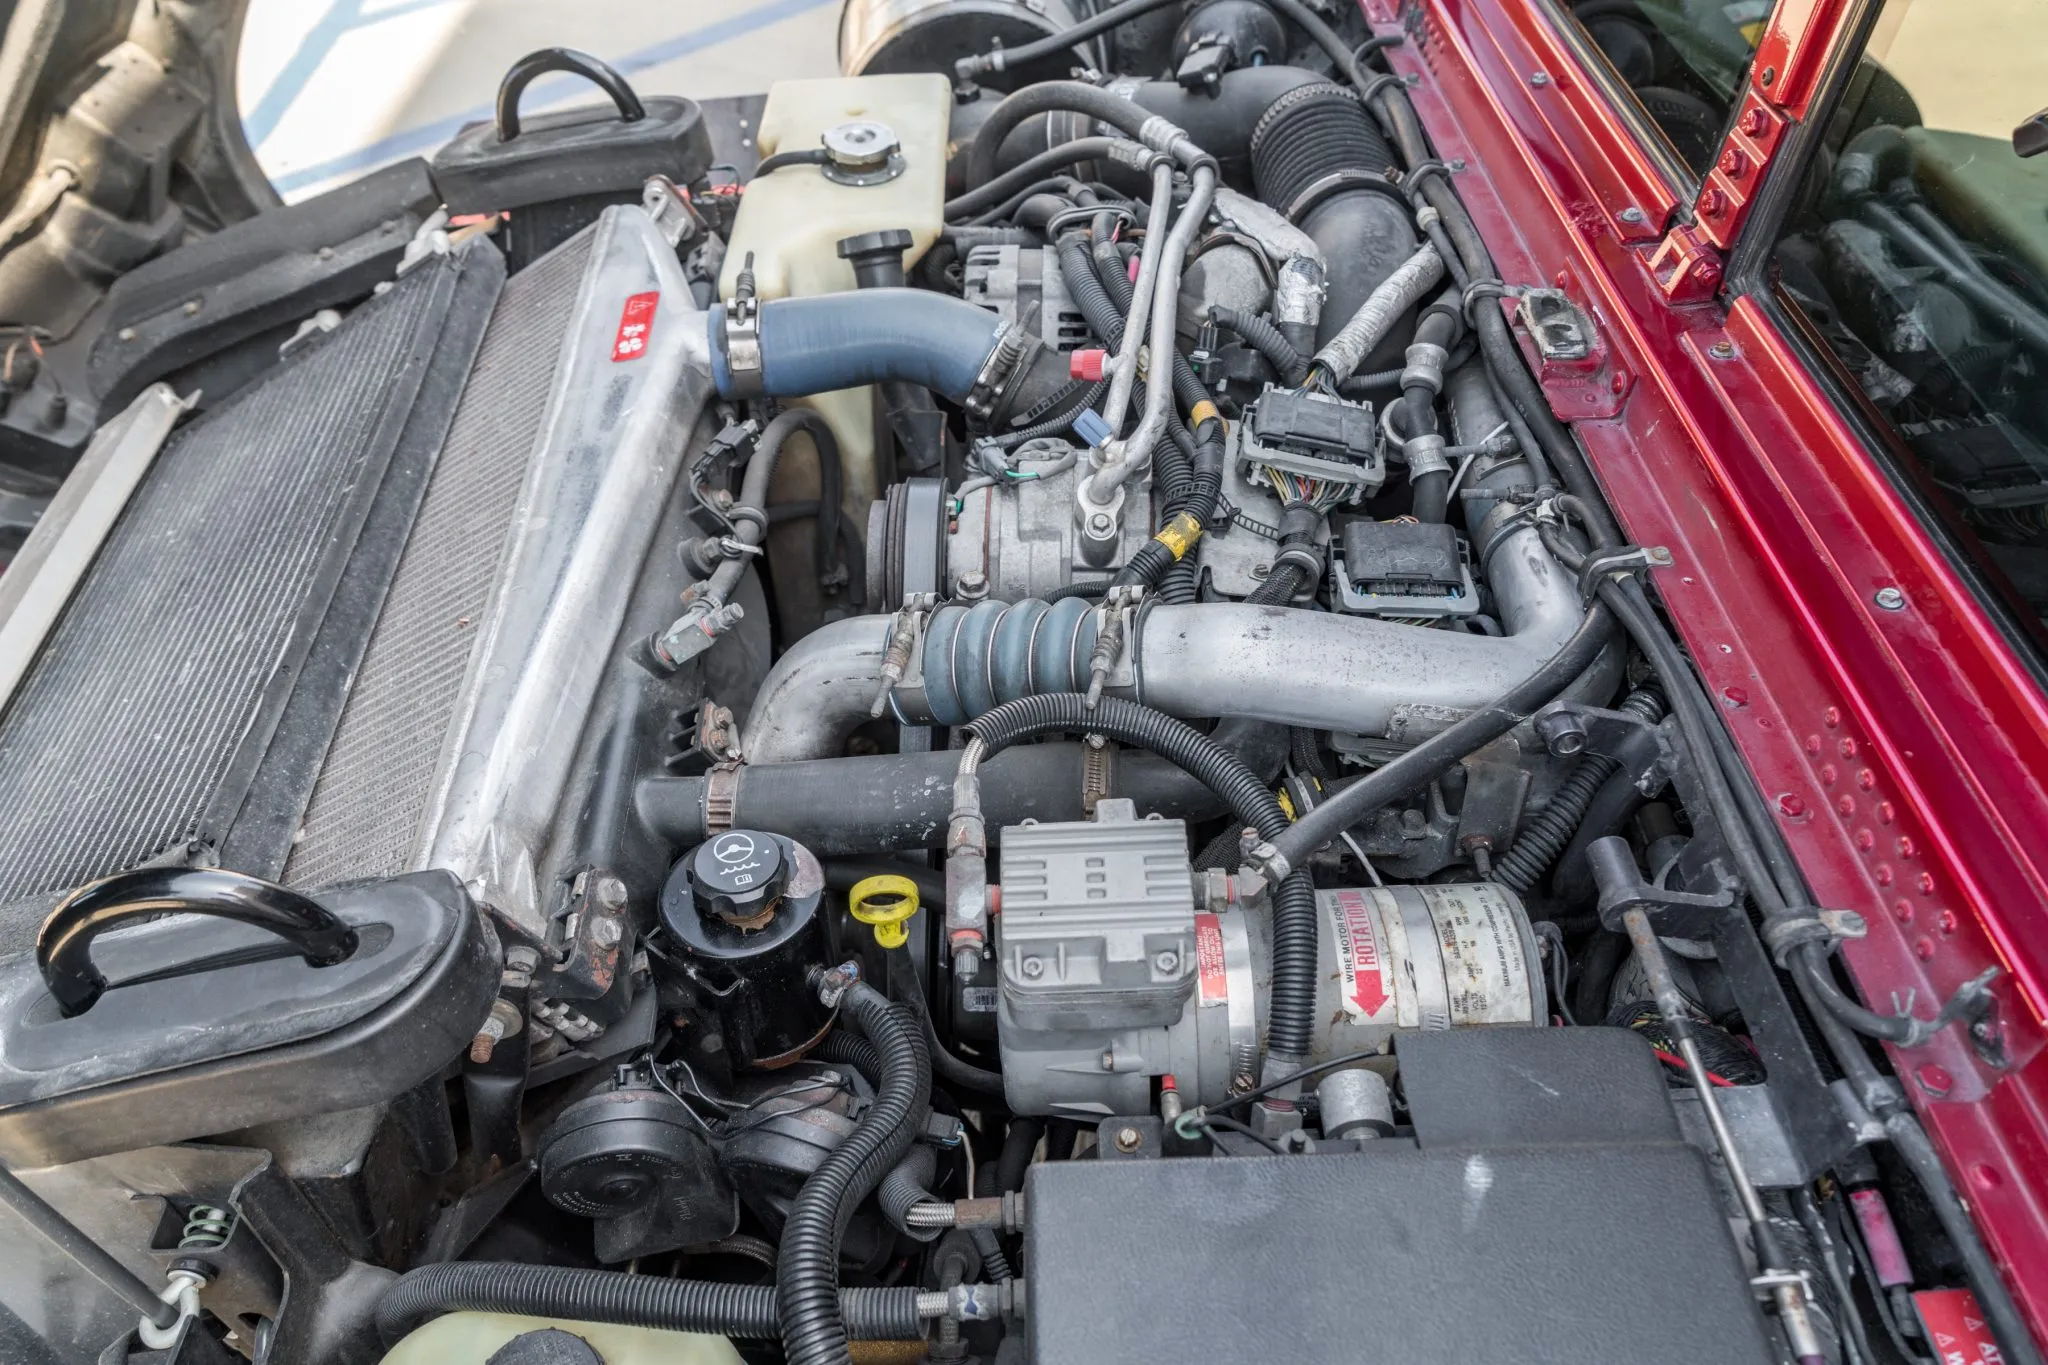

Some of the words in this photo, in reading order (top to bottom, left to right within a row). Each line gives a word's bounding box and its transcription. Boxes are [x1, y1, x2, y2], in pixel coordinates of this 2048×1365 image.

[1335, 907, 1343, 920] FOR
[1338, 922, 1350, 954] MOTOR
[1344, 902, 1375, 966] ROTATION
[1494, 933, 1502, 944] WITH
[1198, 935, 1206, 968] IMPORTANT
[1496, 945, 1505, 960] AMPS
[1208, 970, 1213, 979] DO
[1214, 967, 1218, 977] OR
[1346, 957, 1354, 983] WIRE
[1501, 960, 1511, 986] MAXIMUM
